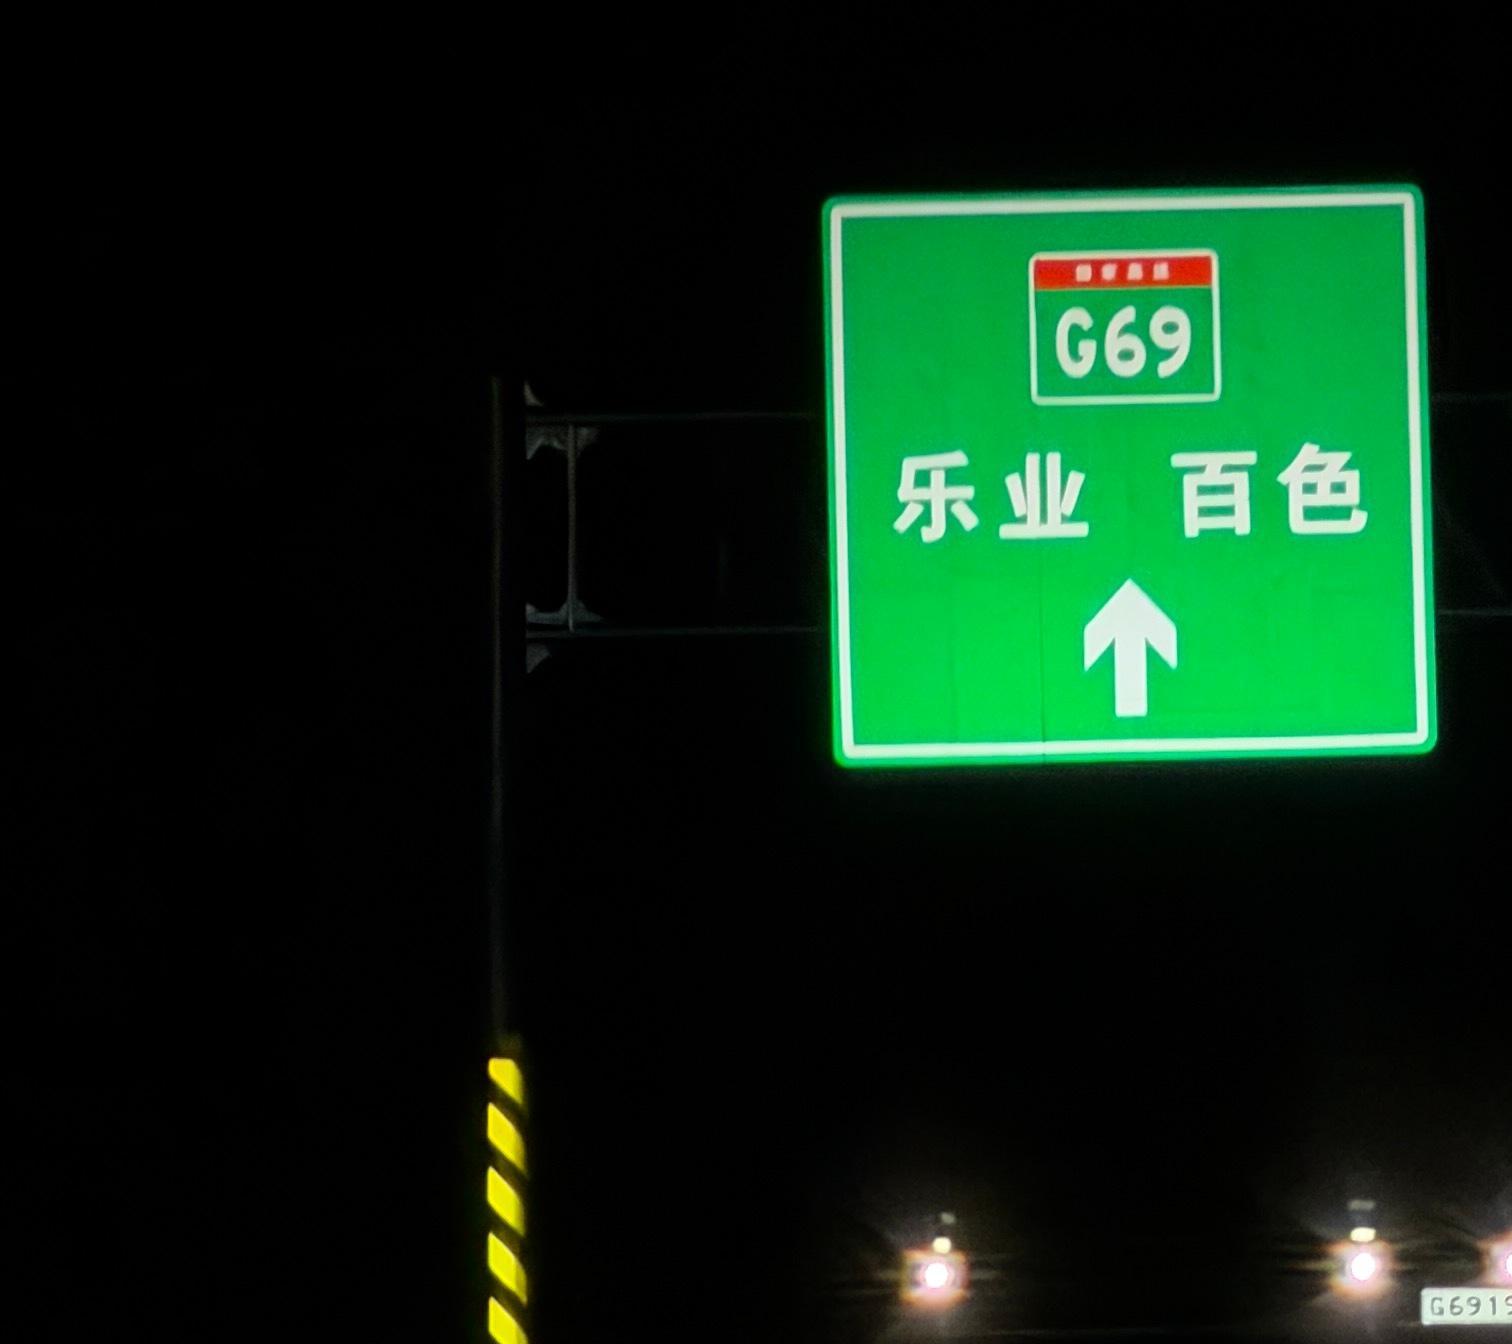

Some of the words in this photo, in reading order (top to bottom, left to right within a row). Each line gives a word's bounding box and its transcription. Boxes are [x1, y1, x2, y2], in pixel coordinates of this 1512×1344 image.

[1056, 306, 1190, 377] G69
[895, 451, 1088, 542] 乐业
[1172, 443, 1367, 537] 百色
